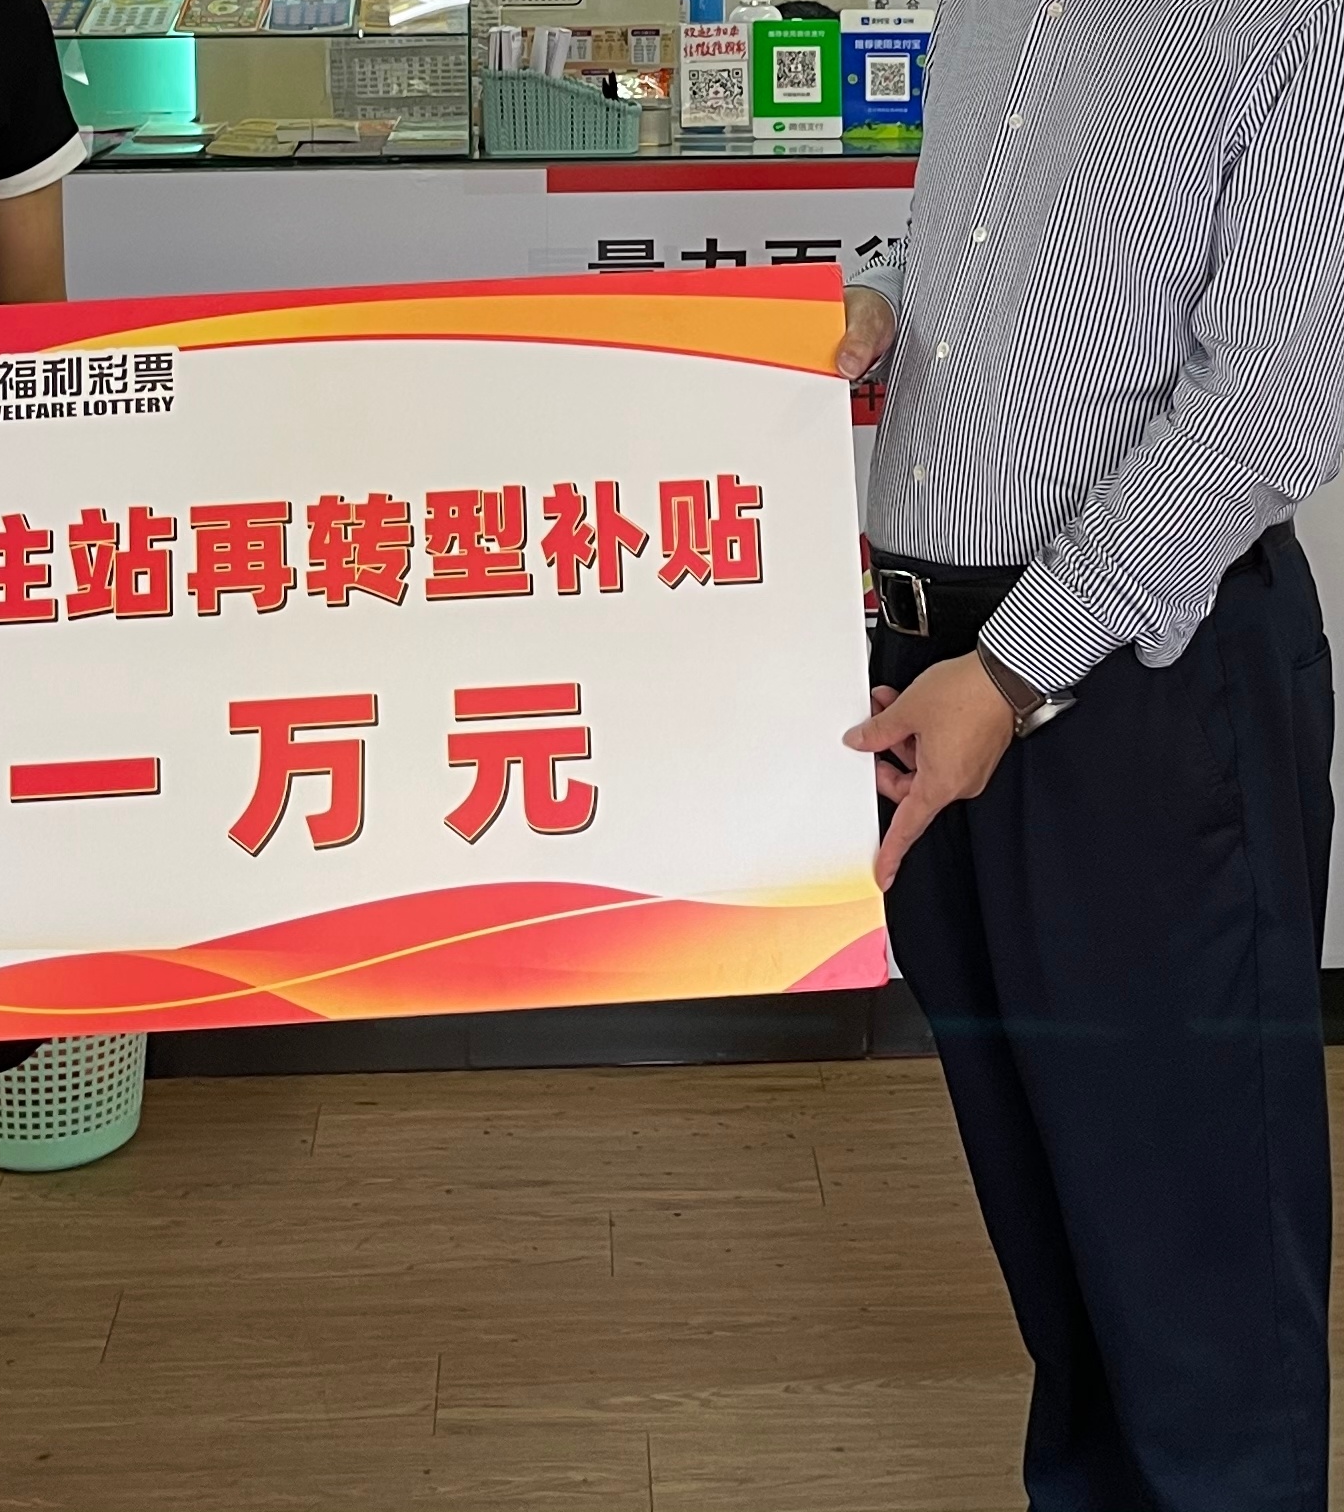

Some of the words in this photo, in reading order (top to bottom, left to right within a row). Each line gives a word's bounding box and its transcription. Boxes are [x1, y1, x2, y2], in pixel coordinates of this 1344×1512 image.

[83, 395, 175, 417] LOTTERY
[9, 680, 599, 857] 一万元
